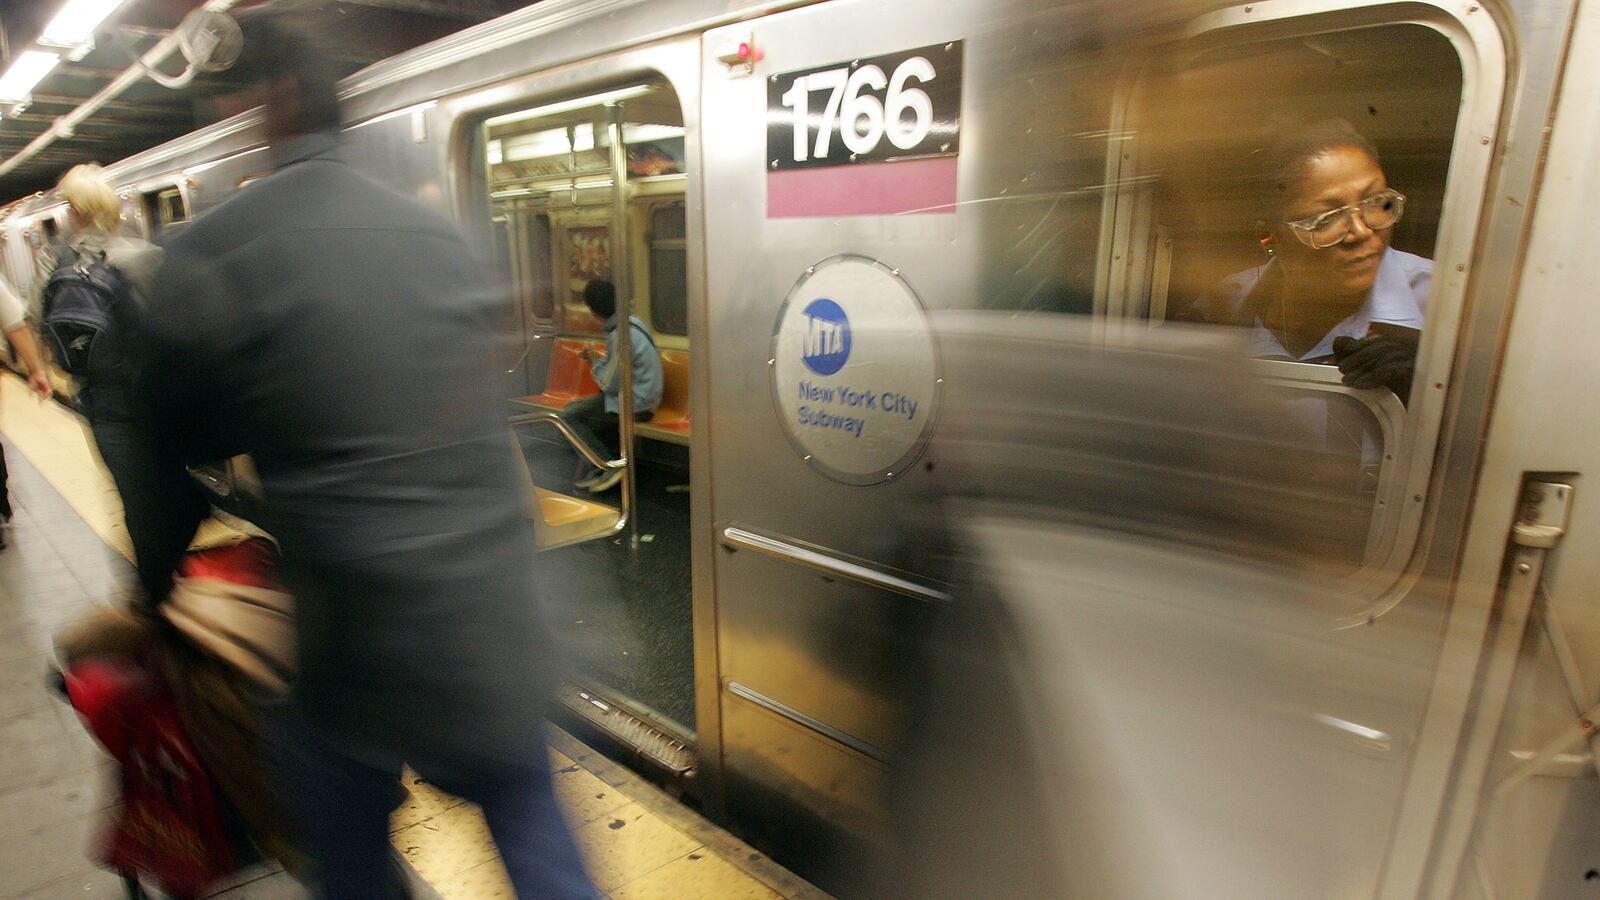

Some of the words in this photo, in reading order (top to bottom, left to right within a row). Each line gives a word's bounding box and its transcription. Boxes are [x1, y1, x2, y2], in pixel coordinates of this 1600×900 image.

[782, 56, 936, 161] 1766
[801, 314, 843, 358] MTA
[798, 406, 864, 437] Subway
[799, 382, 834, 404] New
[837, 386, 877, 409] York
[881, 391, 918, 420] City
